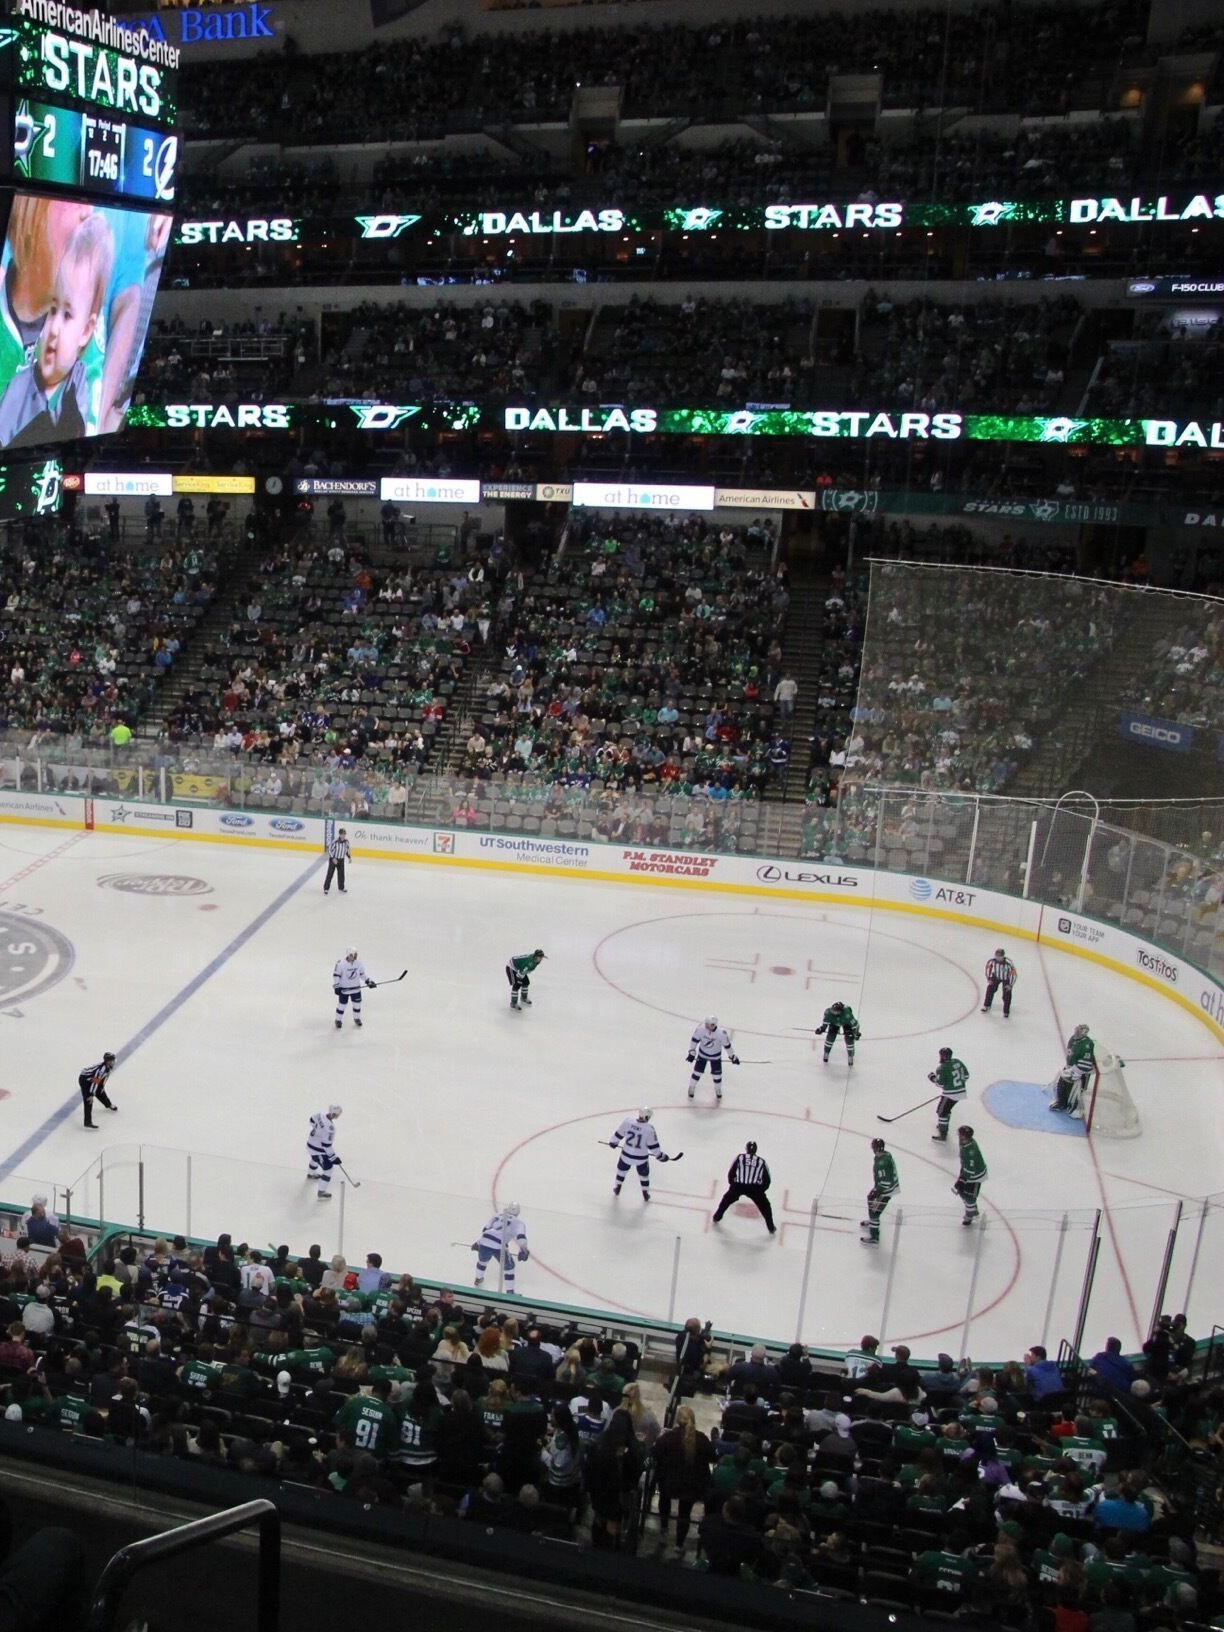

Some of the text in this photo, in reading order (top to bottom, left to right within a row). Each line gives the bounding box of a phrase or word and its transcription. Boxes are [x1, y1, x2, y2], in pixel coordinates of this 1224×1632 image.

[180, 4, 275, 44] Bank
[44, 33, 161, 117] STARS
[42, 114, 56, 158] 2
[88, 149, 119, 180] 17:46
[142, 138, 153, 177] 2
[181, 219, 294, 244] STARS
[482, 209, 624, 235] DALLAS
[764, 203, 903, 229] STARS
[1171, 283, 1197, 292] F-150
[167, 404, 289, 428] STARS
[504, 407, 657, 433] DALLAS
[811, 411, 962, 440] STARS
[96, 480, 113, 491] at
[394, 484, 411, 497] at
[499, 491, 532, 499] ENERGY
[604, 490, 622, 503] at
[719, 495, 795, 505] American Airlines
[963, 502, 1118, 521] STARS ESTD 1993
[1129, 721, 1181, 744] GEICO
[25, 802, 54, 812] Airlines
[225, 815, 248, 826] Ford
[276, 819, 297, 831] Ford
[370, 833, 392, 842] thank
[496, 838, 589, 857] Southwestern
[516, 852, 588, 867] Medical Center
[623, 851, 719, 867] P.M. STANDLEY
[630, 861, 710, 877] MOTORCARS
[785, 871, 858, 887] LEXUS
[935, 887, 977, 907] AT&T
[625, 1130, 643, 1149] 21
[745, 1158, 757, 1167] 58
[355, 1418, 380, 1450] 91
